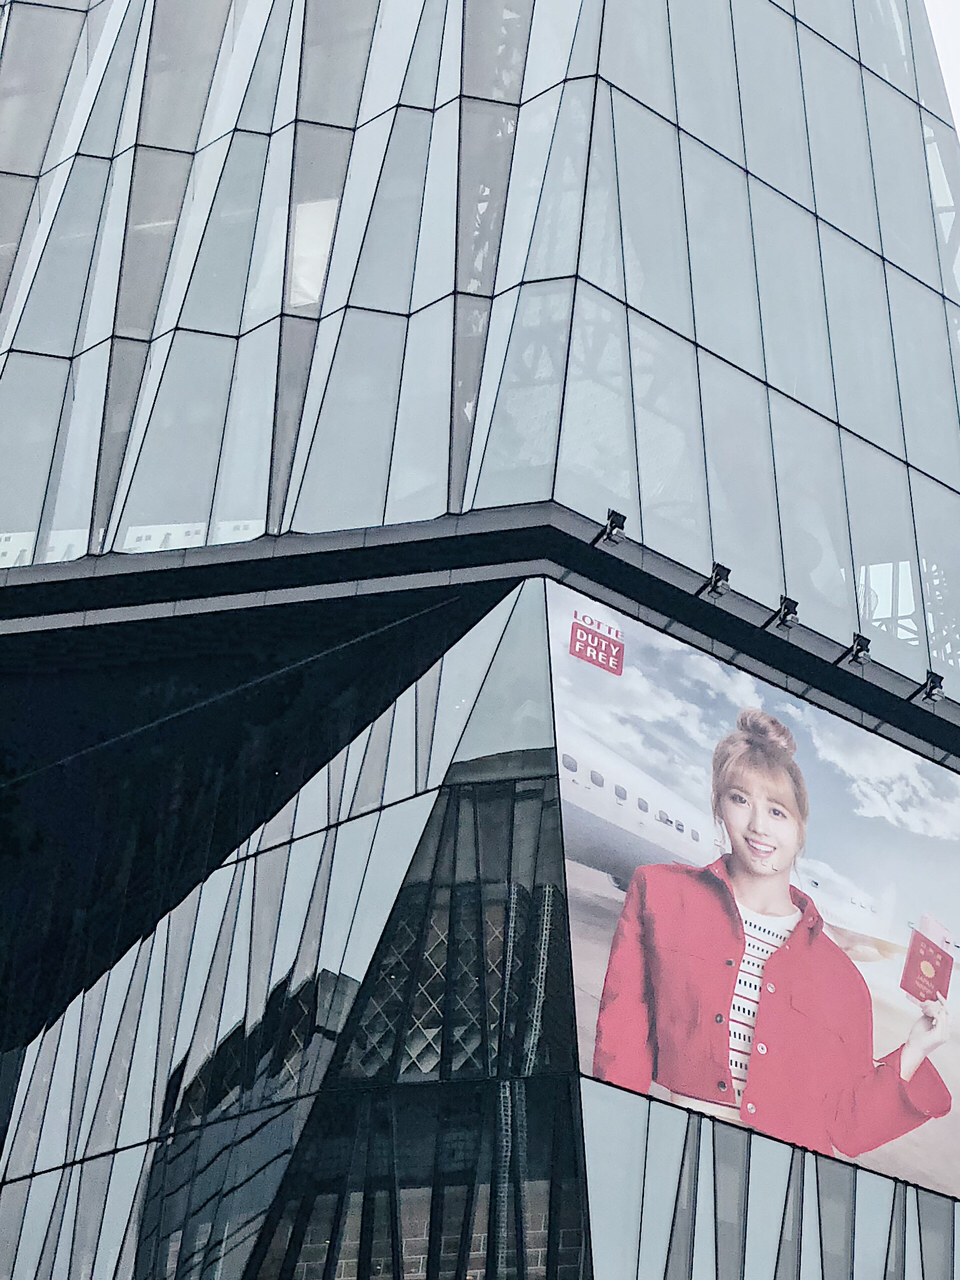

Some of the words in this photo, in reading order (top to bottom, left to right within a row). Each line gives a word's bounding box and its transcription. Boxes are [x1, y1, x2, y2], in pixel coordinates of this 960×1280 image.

[573, 610, 625, 642] LOTTE
[574, 641, 618, 670] FREE
[575, 628, 620, 656] DUTY
